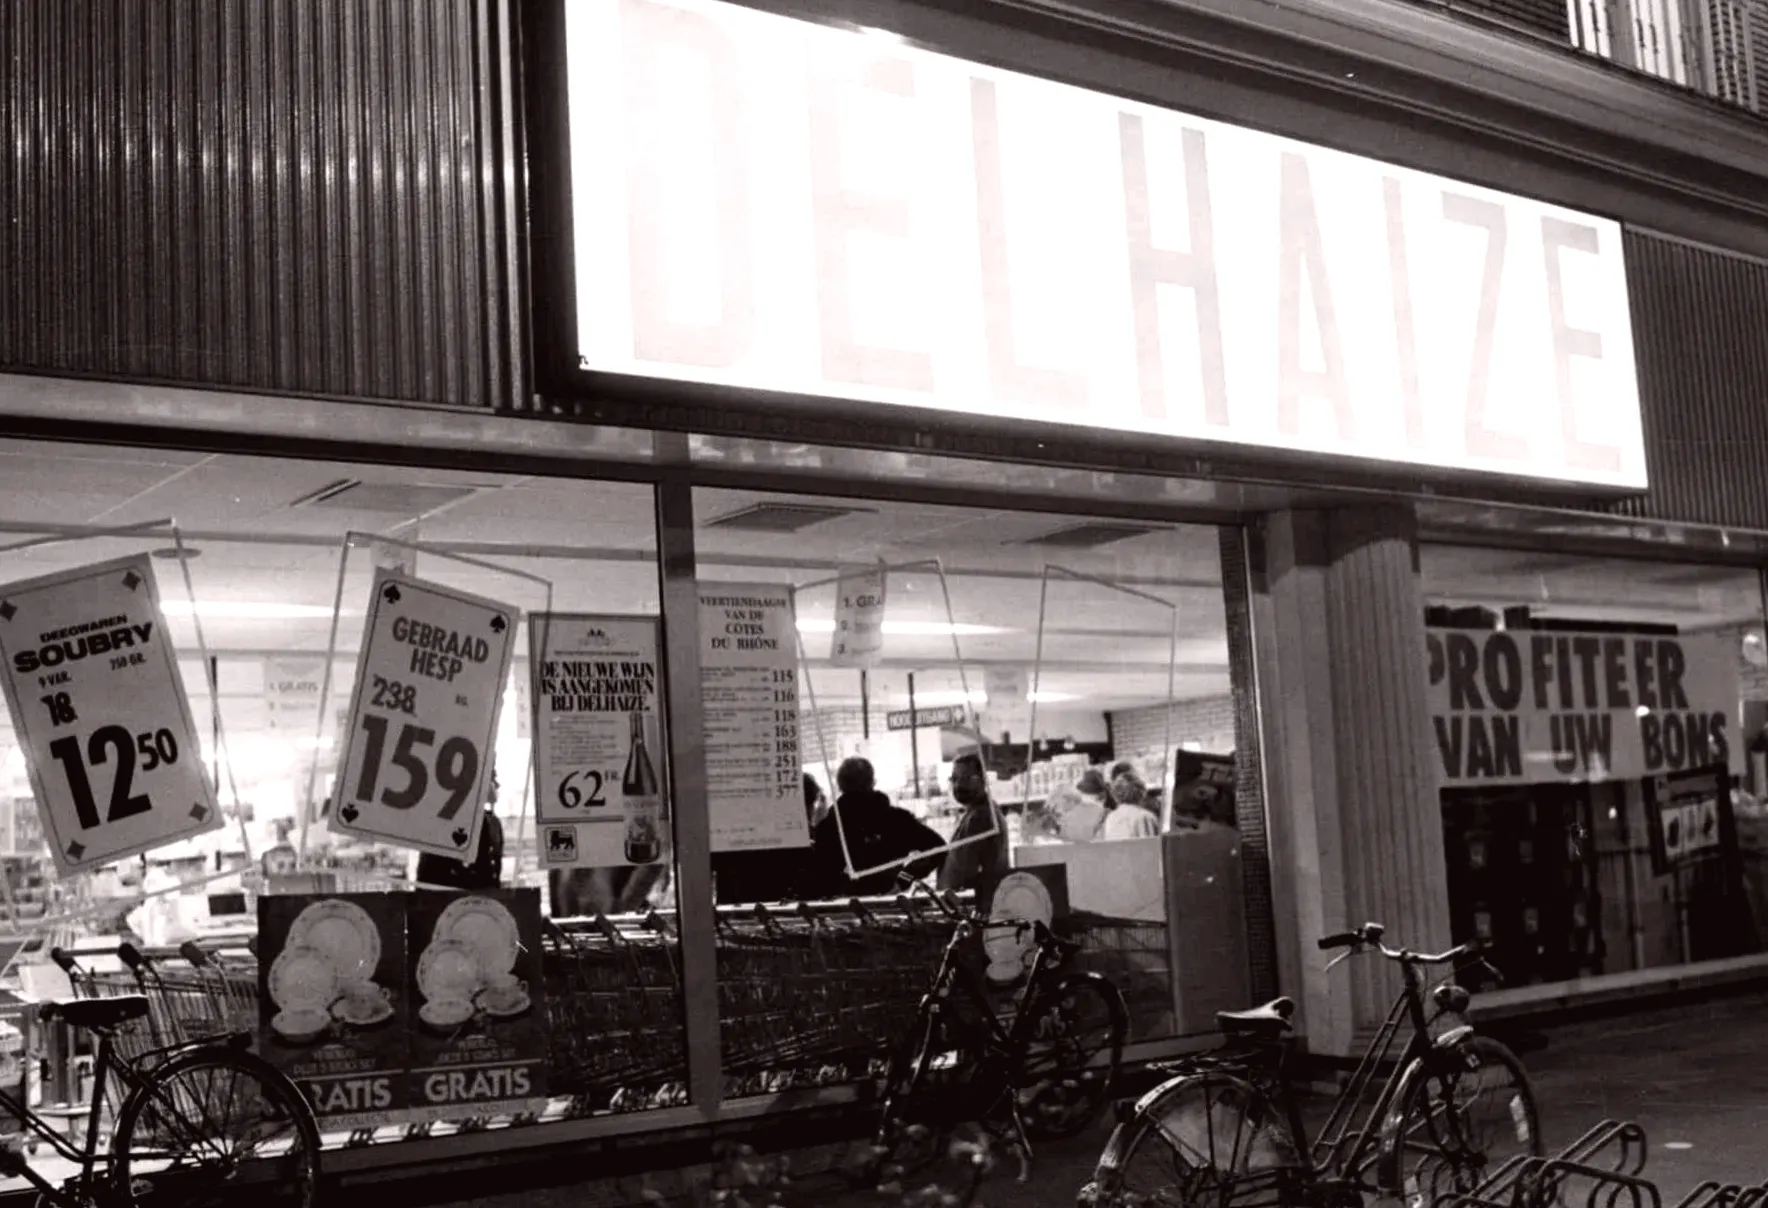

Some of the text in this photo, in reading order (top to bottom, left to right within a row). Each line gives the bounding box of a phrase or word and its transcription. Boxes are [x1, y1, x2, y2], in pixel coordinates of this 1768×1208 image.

[618, 0, 1622, 472] DELHAIZE
[13, 622, 153, 674] SOUBRY
[392, 616, 489, 664] GEBRAAD
[409, 647, 464, 683] HESP
[541, 661, 655, 678] DE NIEUWE WIJN
[541, 679, 655, 694] IS AANGEKOMEN
[551, 694, 574, 712] BIJ
[1433, 711, 1728, 779] VAN UW BONS
[355, 712, 479, 820] 159
[558, 770, 606, 809] 62
[310, 1078, 392, 1112] RATIS
[424, 1067, 531, 1102] GRATIS
